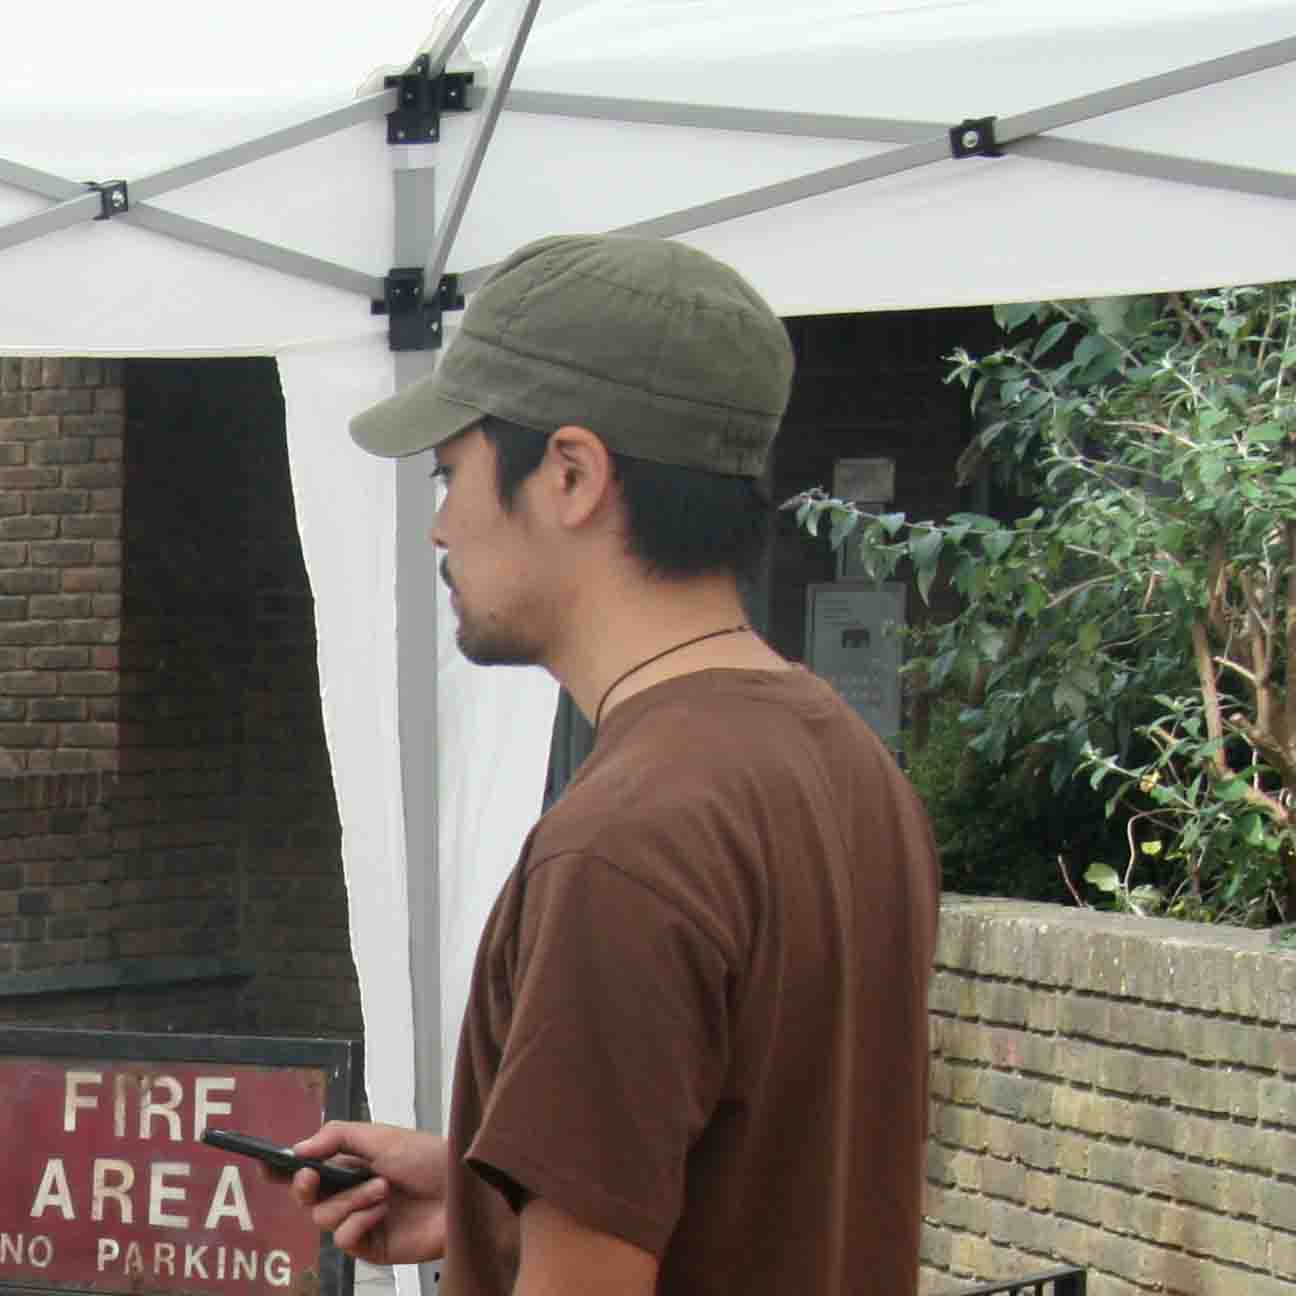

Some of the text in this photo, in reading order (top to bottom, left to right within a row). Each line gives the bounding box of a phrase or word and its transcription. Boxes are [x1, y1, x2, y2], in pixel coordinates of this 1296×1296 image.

[63, 1071, 236, 1142] FIRE
[29, 1157, 255, 1232] AREA
[96, 1237, 292, 1288] PARKING
